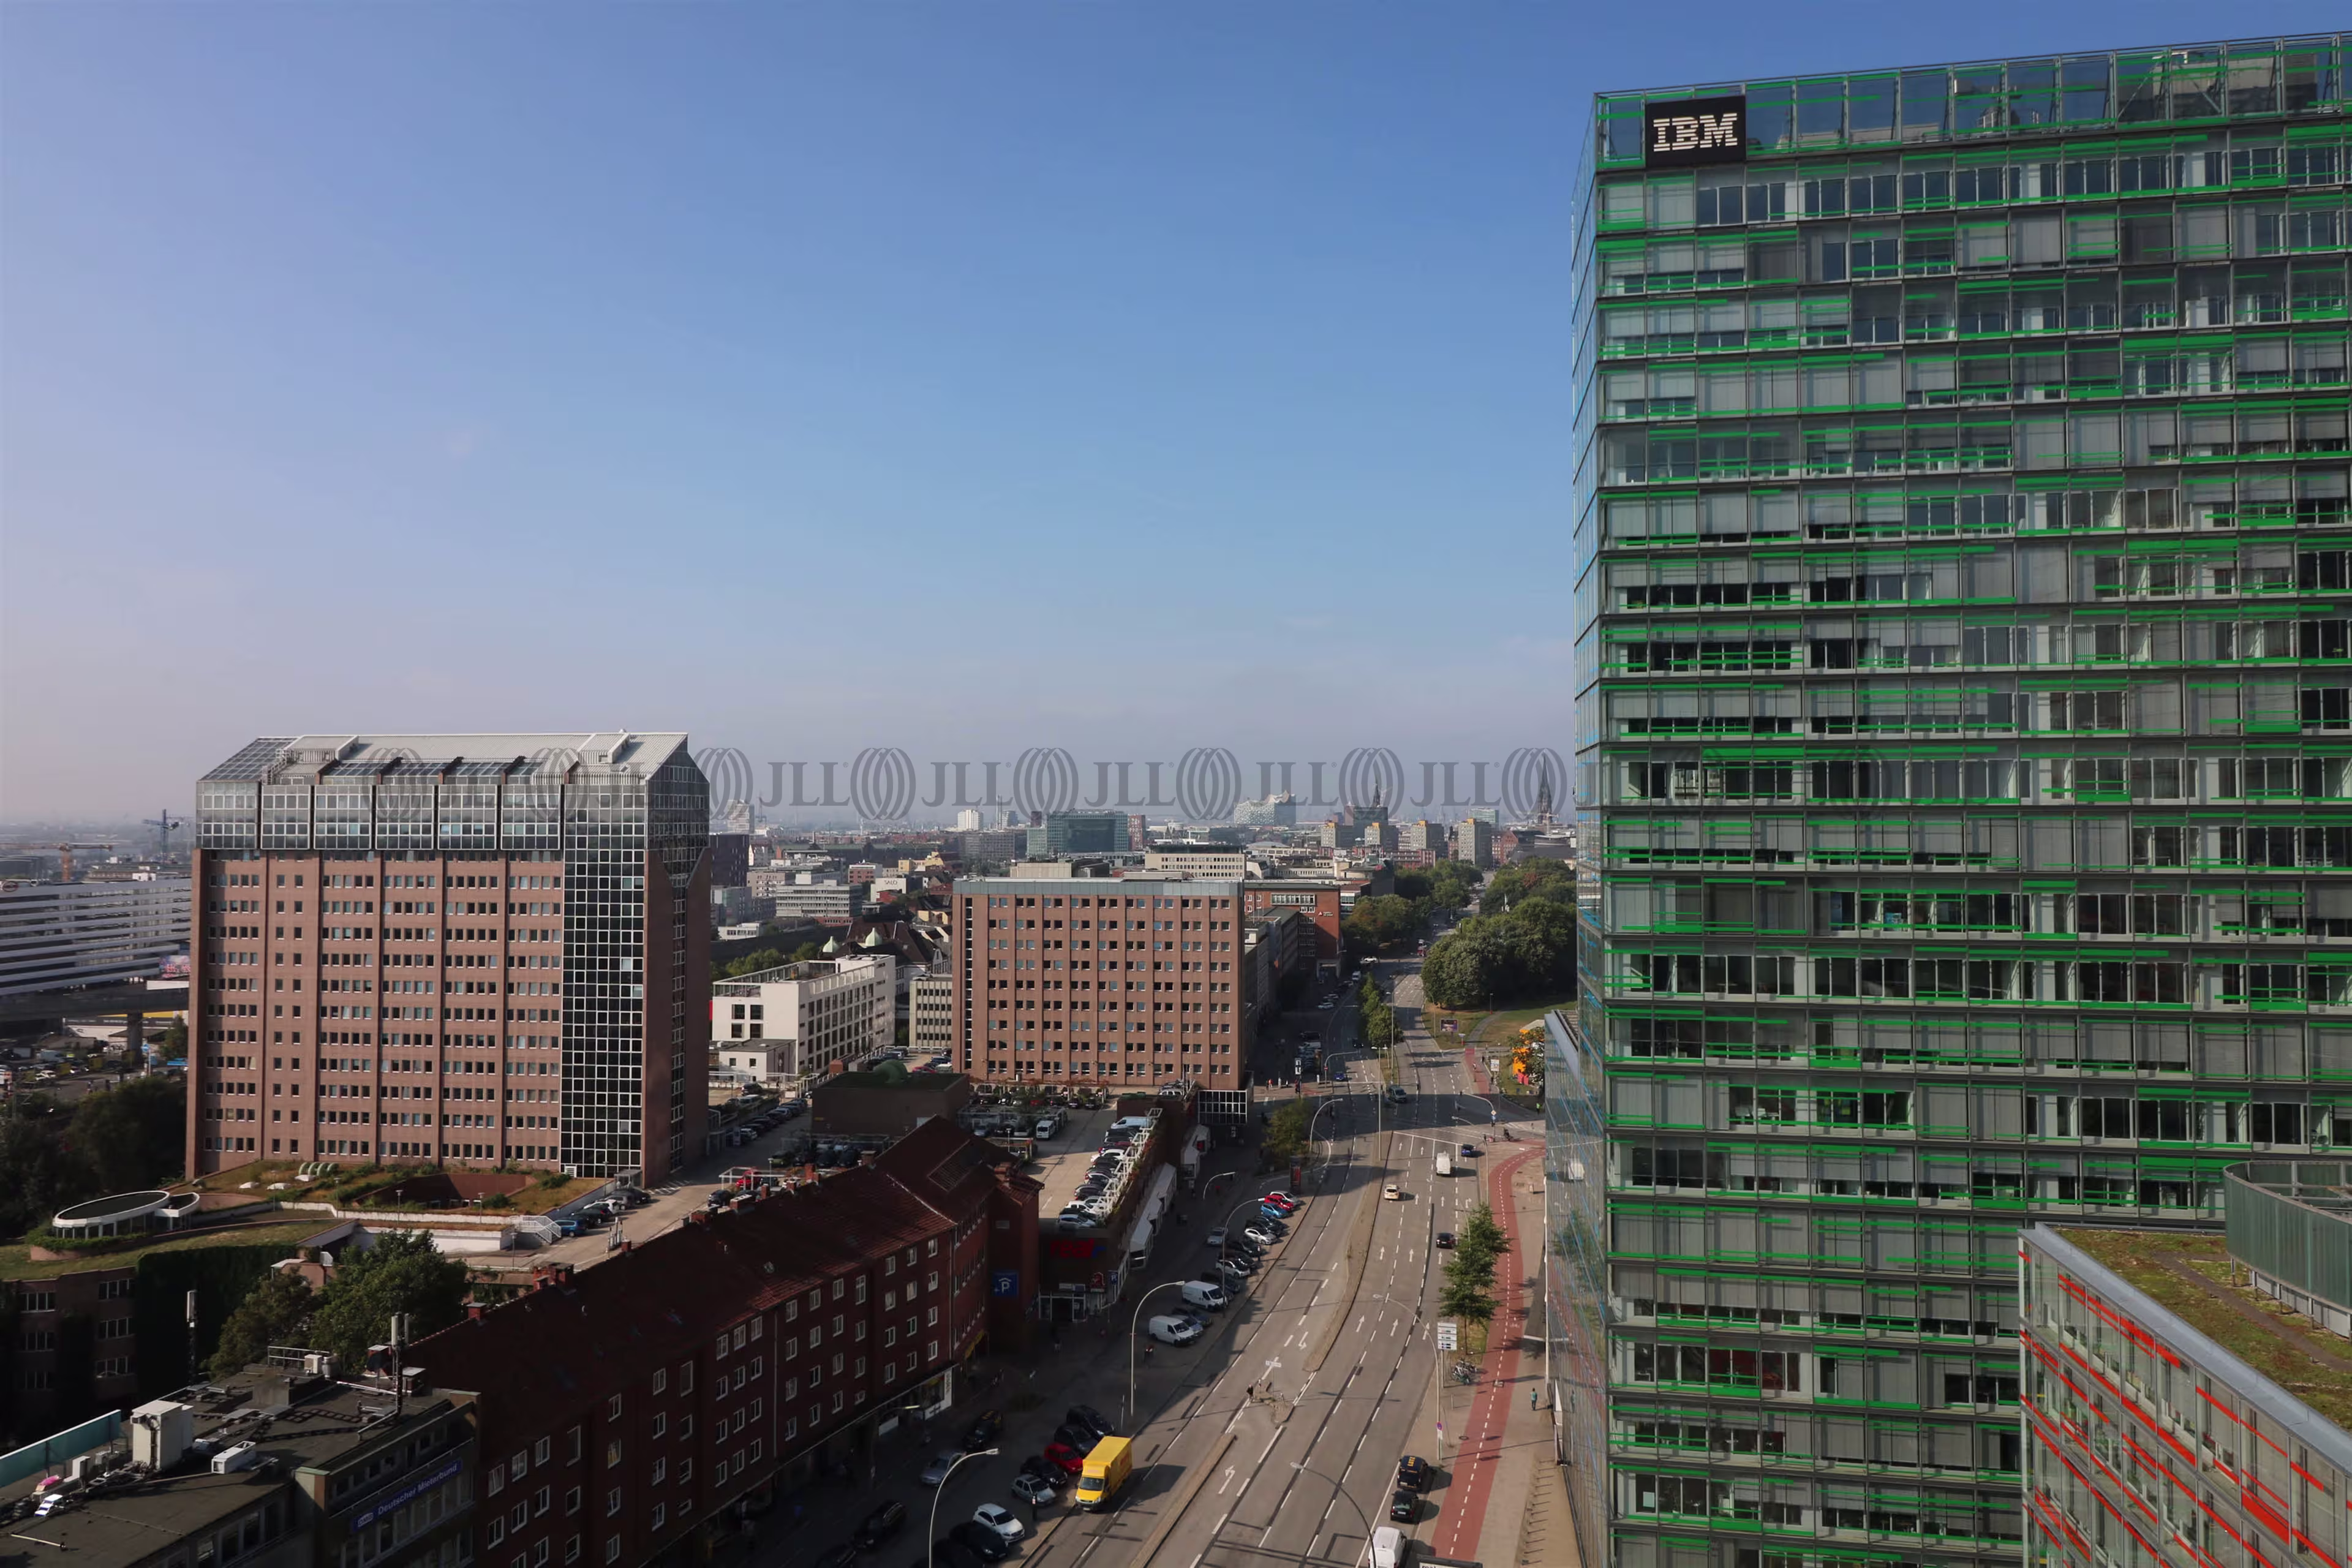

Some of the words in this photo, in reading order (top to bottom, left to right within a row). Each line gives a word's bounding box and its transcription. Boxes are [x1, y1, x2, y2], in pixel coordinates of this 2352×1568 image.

[1653, 113, 1738, 151] IBM
[1001, 1281, 1010, 1293] P
[378, 1488, 416, 1515] Deutscher
[418, 1463, 458, 1493] Mieterbund
